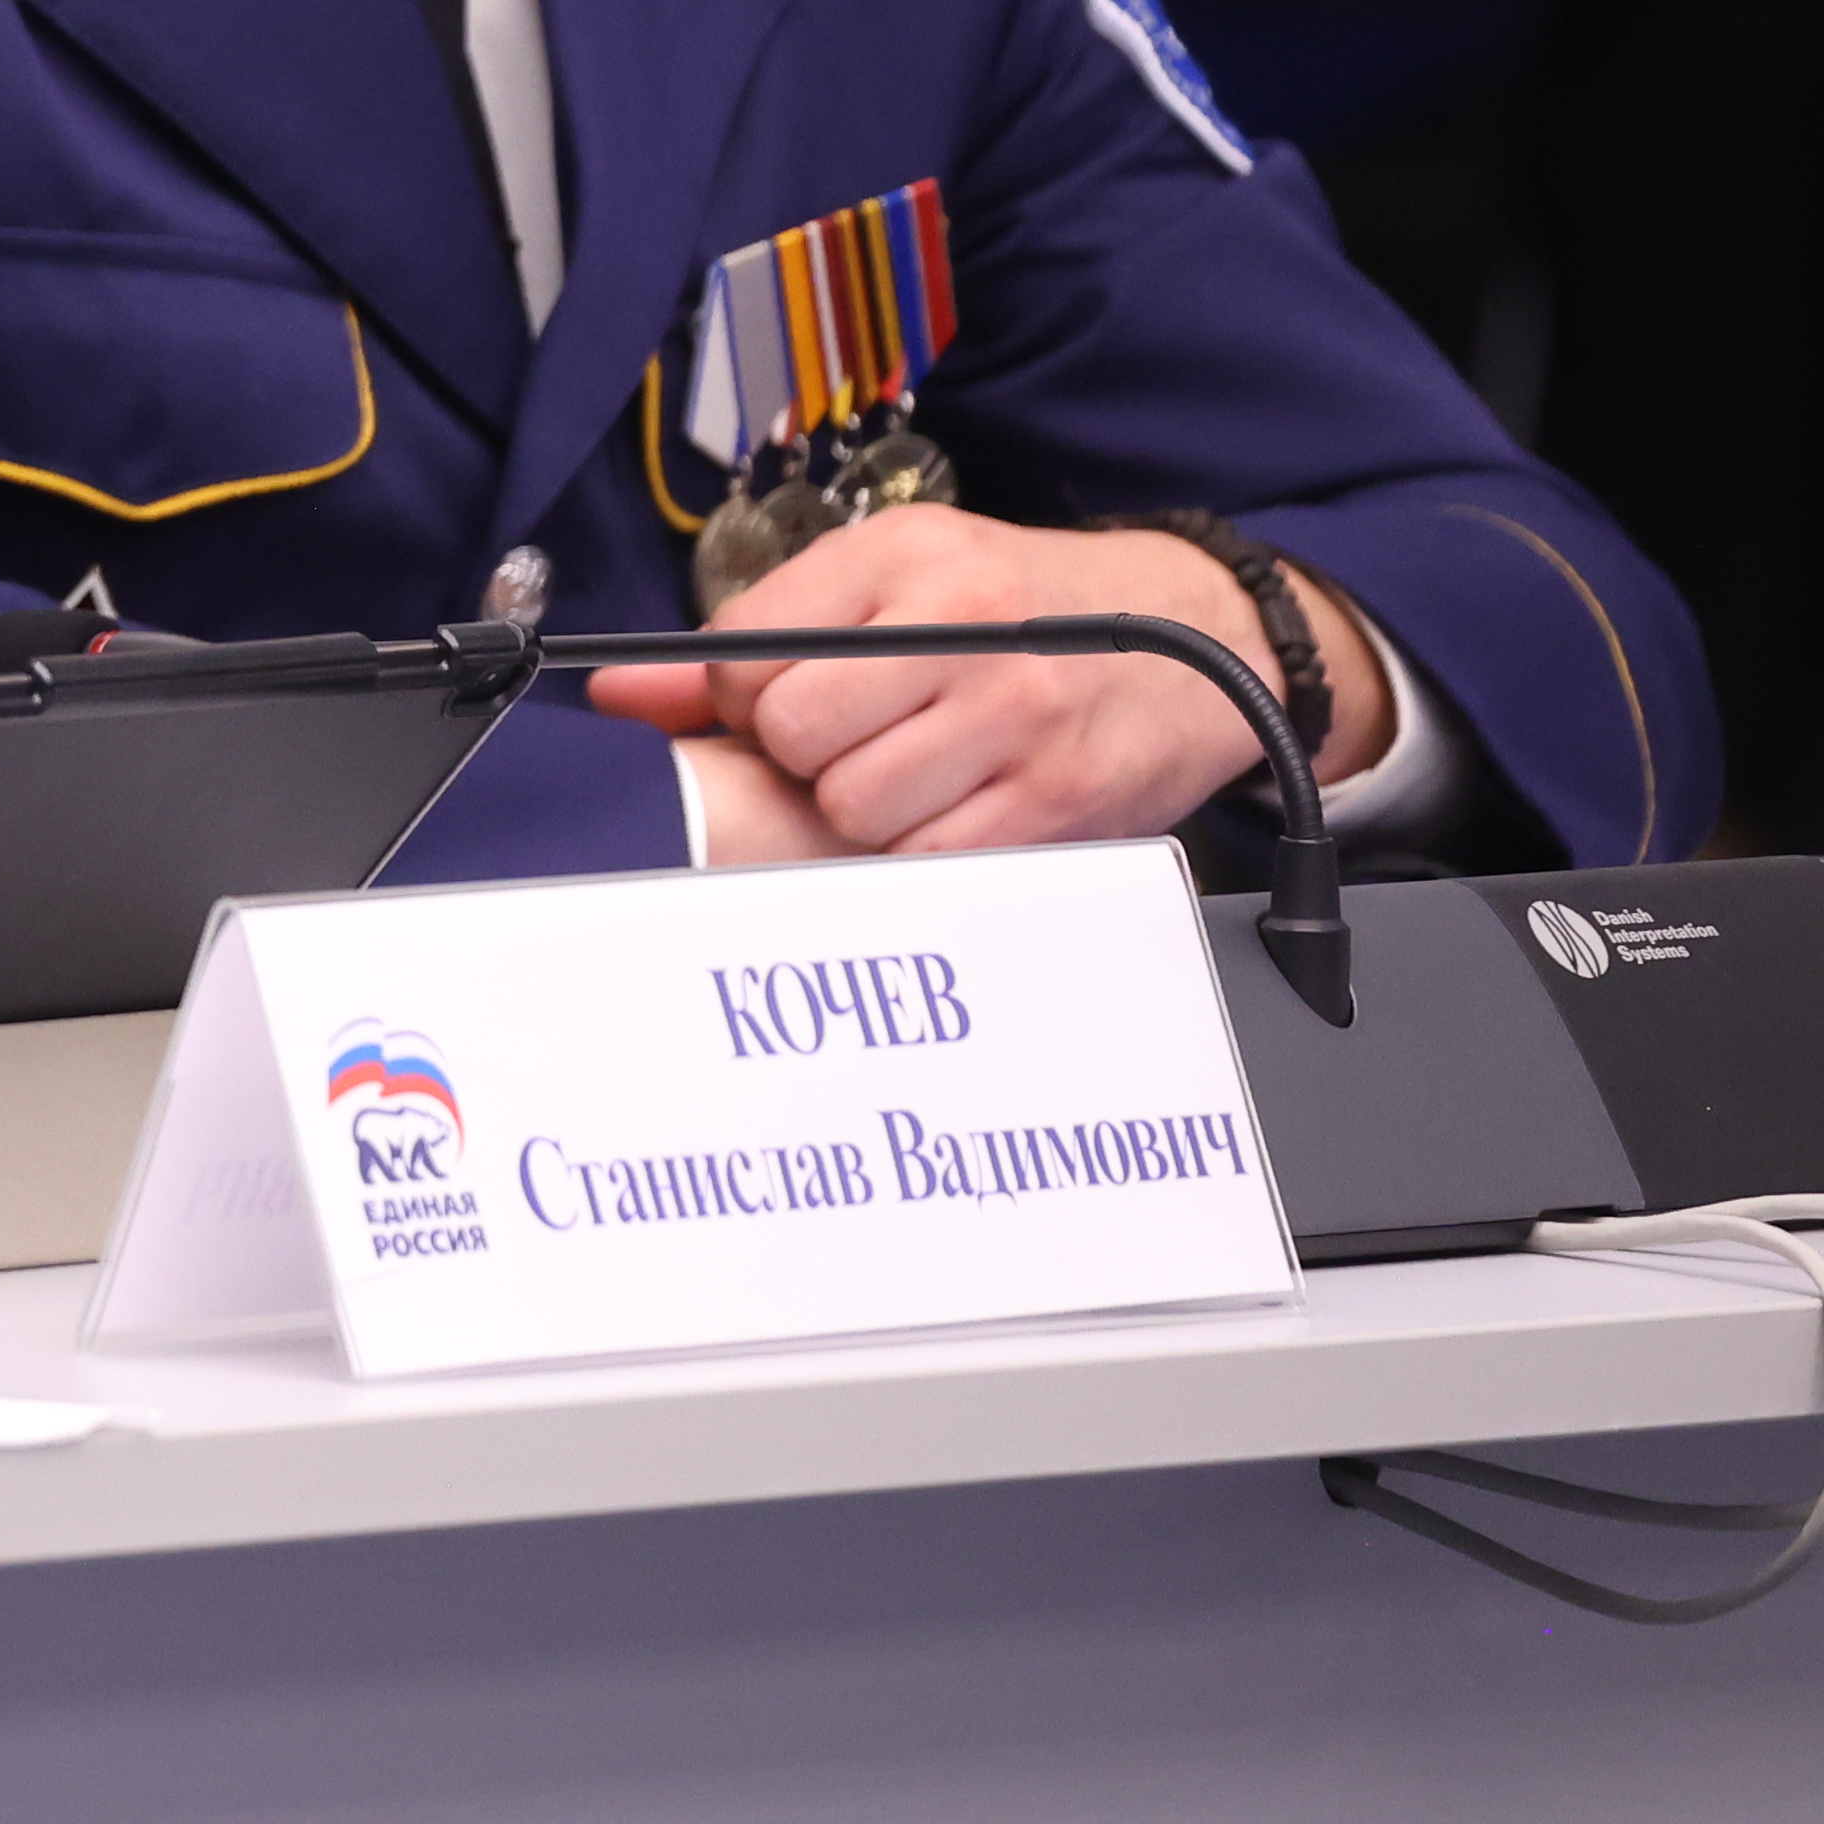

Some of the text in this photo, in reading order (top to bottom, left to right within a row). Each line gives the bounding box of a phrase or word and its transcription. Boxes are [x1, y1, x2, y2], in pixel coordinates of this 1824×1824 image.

[1592, 907, 1655, 926] Danish
[1603, 922, 1720, 945] Interpretation
[1616, 944, 1690, 965] Systems
[710, 952, 972, 1059] КОЧЕВ
[518, 1108, 1250, 1231] Станислав Вадимович
[362, 1191, 479, 1225] ЕДИНАЯ
[372, 1224, 489, 1260] РОССИЯ
